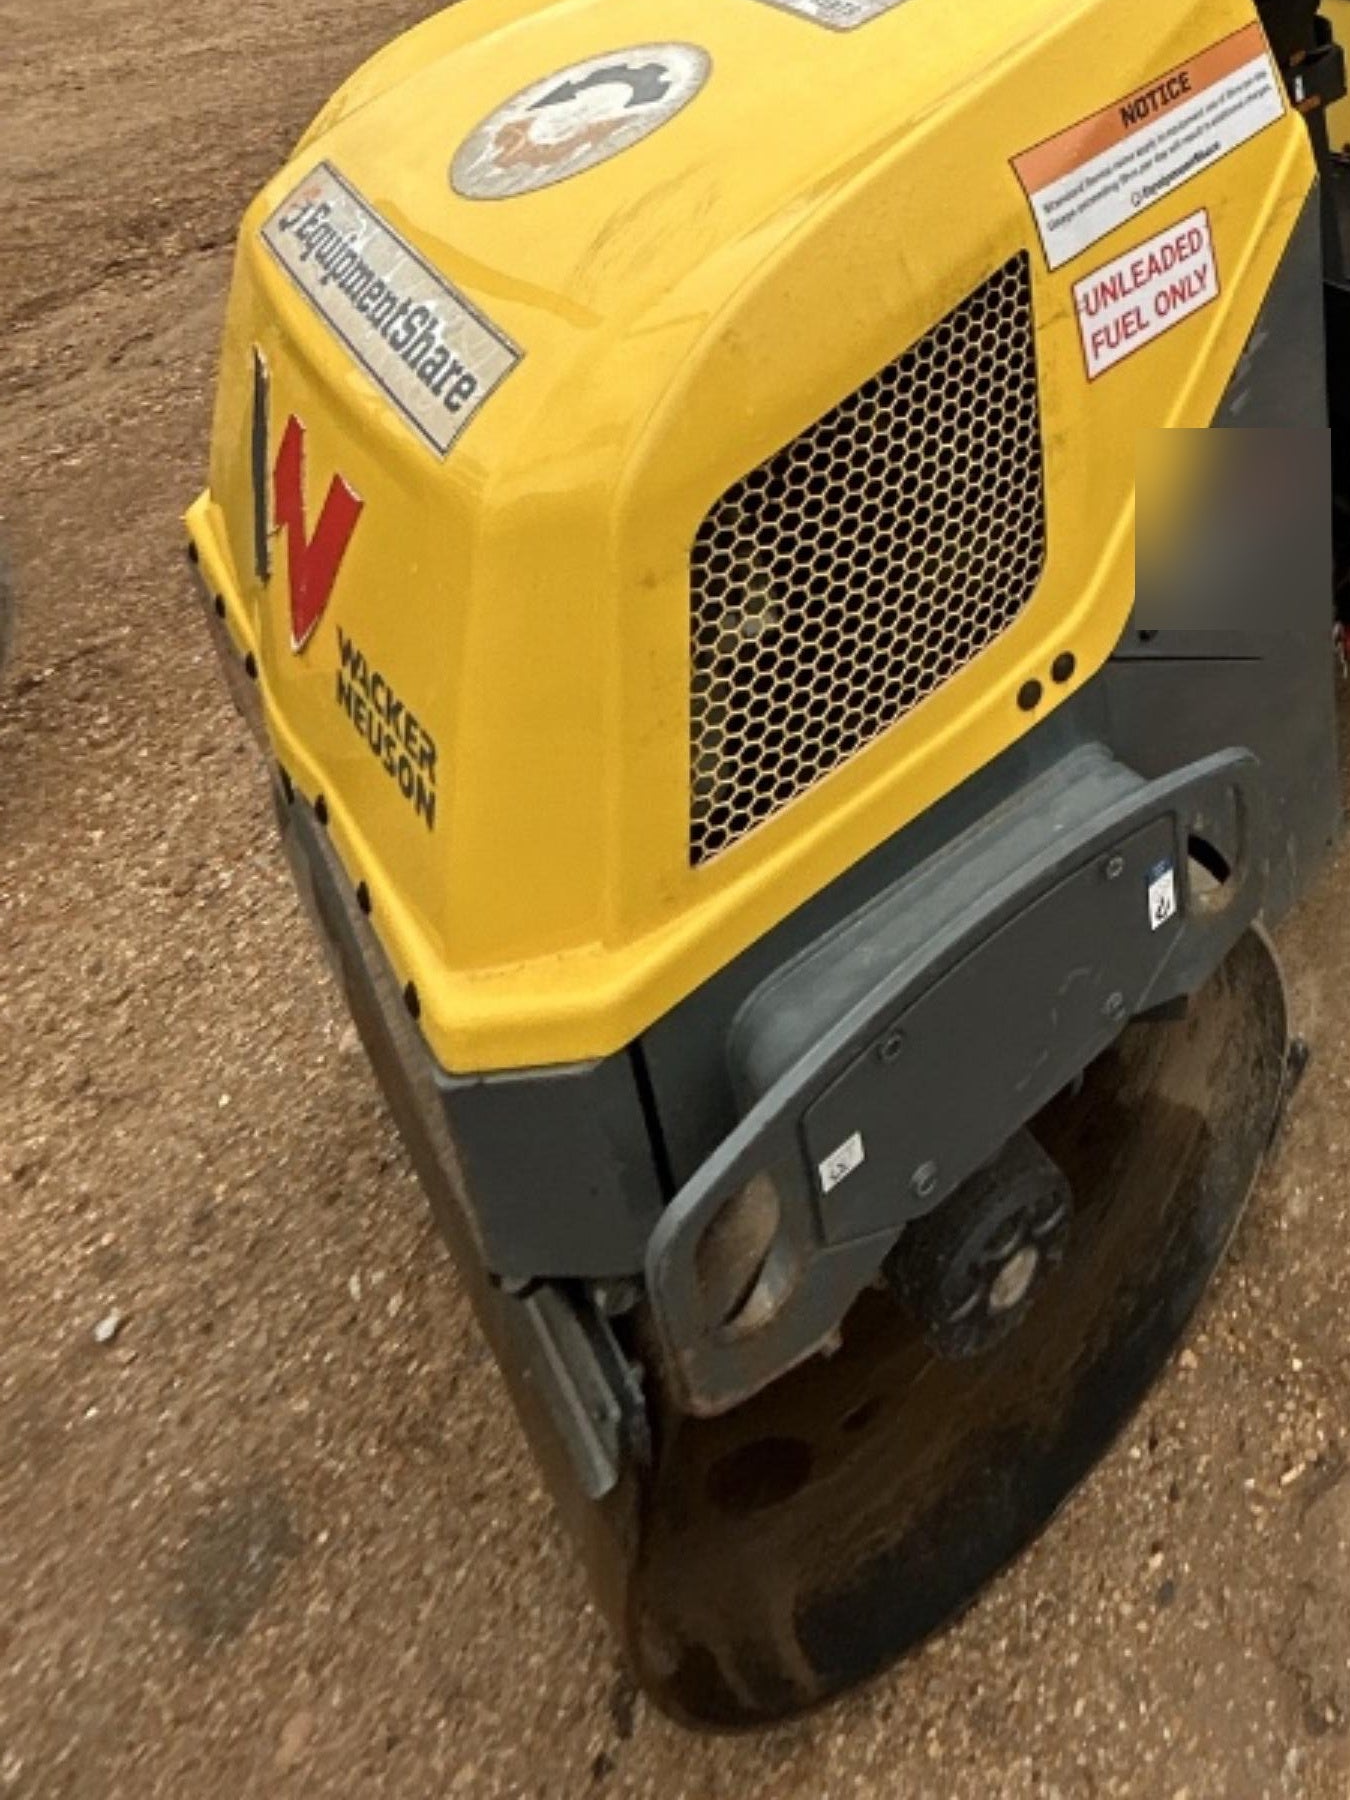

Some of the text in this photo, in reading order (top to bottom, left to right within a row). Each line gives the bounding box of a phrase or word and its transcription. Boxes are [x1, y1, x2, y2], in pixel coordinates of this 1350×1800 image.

[1118, 71, 1193, 129] NOTICE
[294, 201, 478, 414] EquipmentShare
[1083, 227, 1204, 317] UNLEADED
[1091, 263, 1208, 361] FUEL ONLY
[335, 669, 436, 832] NEUSON
[336, 624, 437, 777] WACKER
